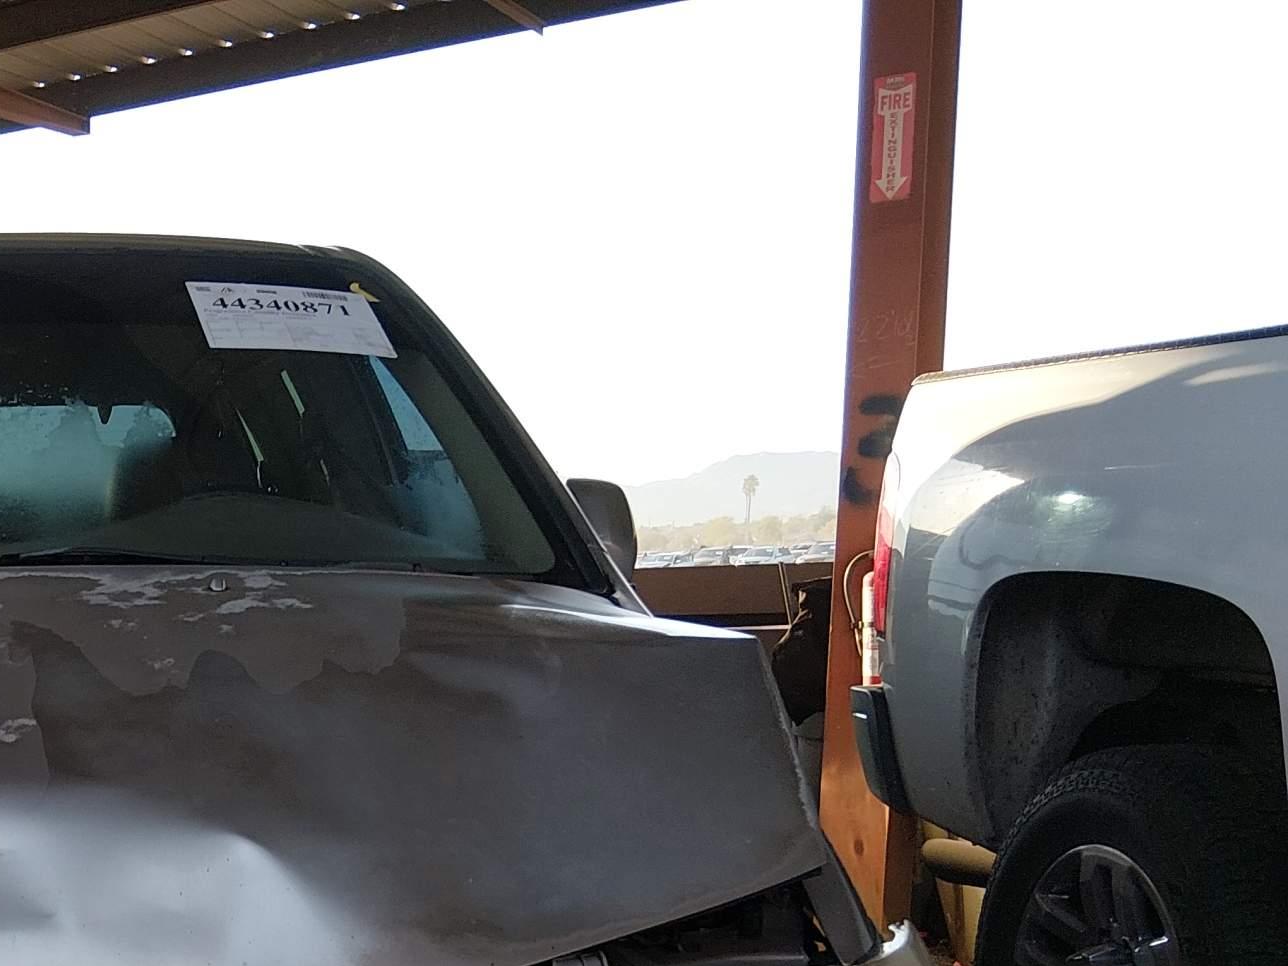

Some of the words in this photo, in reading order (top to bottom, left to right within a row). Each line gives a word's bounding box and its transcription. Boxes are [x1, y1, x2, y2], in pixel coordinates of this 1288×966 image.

[880, 92, 911, 112] FIRE
[885, 112, 899, 193] EXTINGUISHER
[212, 296, 351, 317] 44340871
